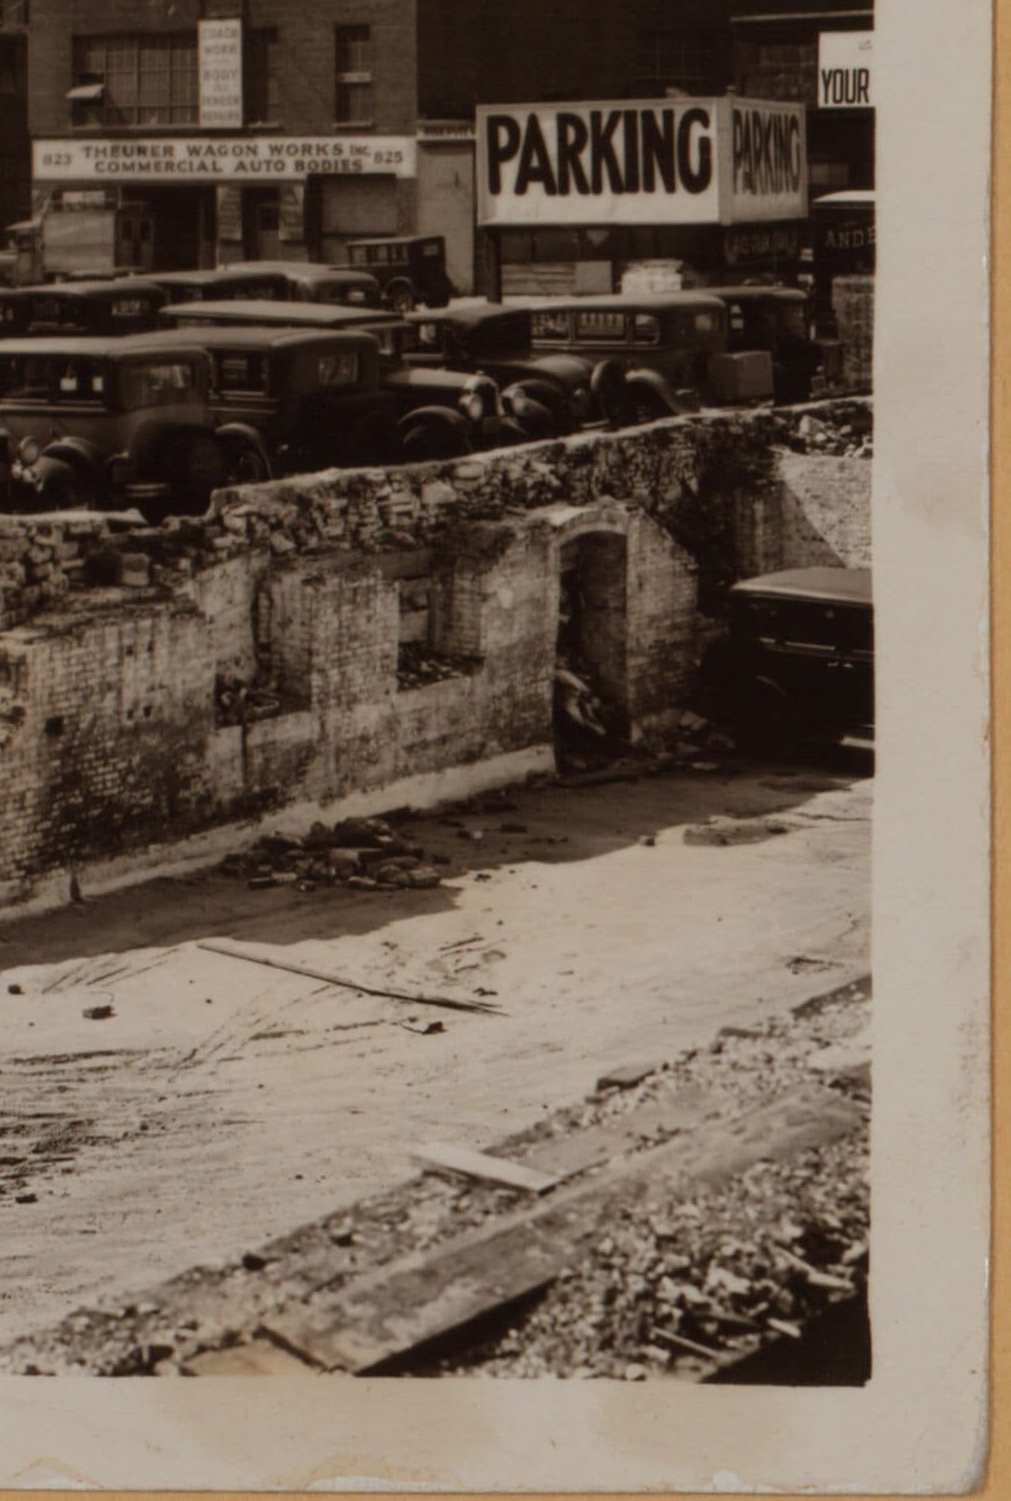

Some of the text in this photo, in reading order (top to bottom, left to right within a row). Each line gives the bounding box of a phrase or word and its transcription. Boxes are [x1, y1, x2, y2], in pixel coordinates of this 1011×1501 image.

[821, 67, 871, 105] YOUR
[84, 144, 175, 158] THEURER
[186, 143, 259, 157] WAGON
[268, 143, 344, 157] WORKS
[374, 150, 403, 164] 825
[486, 108, 711, 196] PARKING
[732, 108, 801, 197] PARKING
[95, 159, 364, 174] COMMERCIAL AUTO BODIES
